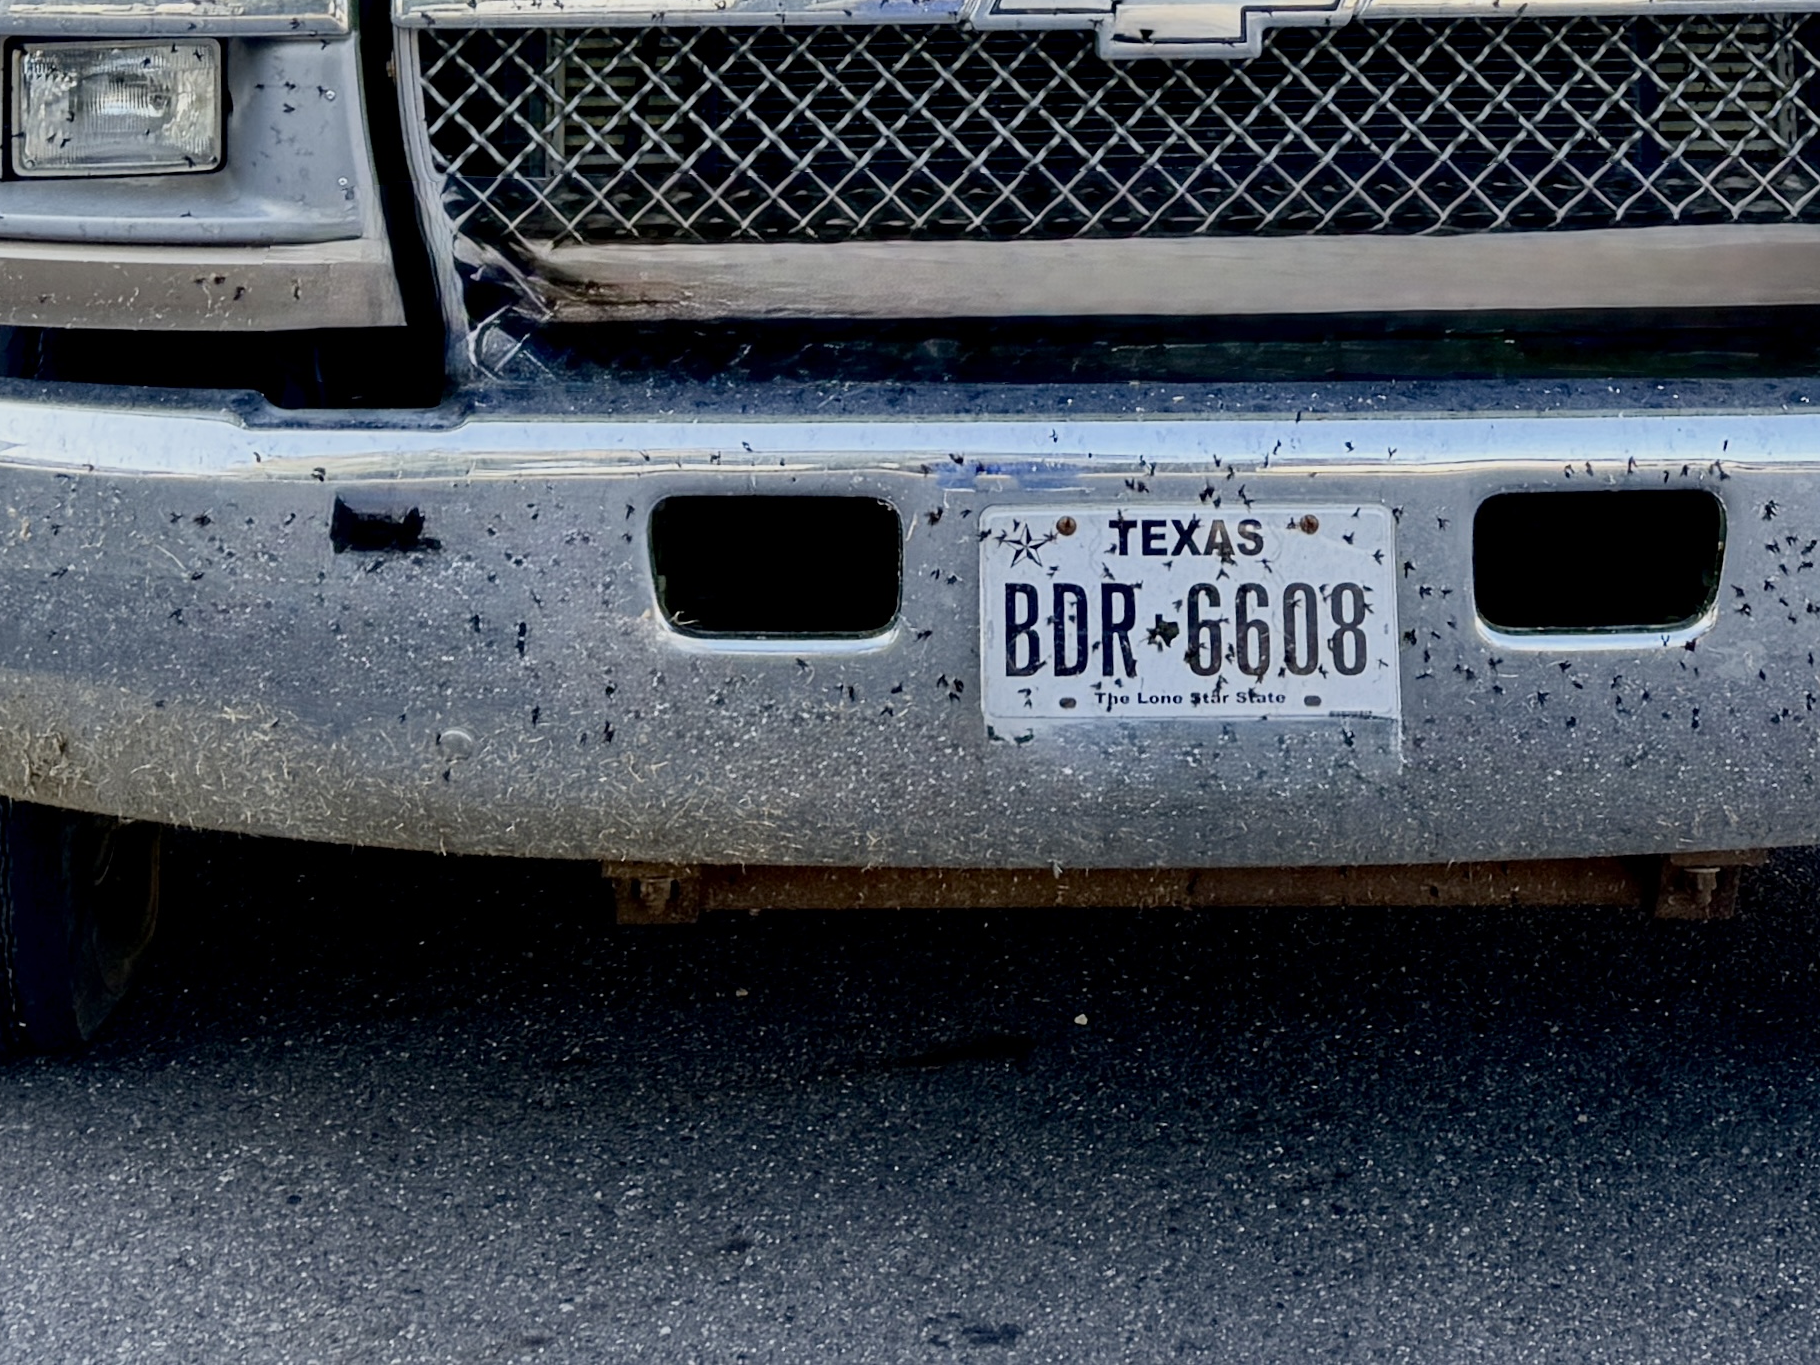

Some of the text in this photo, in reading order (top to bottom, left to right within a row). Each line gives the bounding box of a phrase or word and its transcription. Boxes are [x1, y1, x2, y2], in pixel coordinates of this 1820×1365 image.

[1109, 519, 1264, 556] TEXAS
[1005, 582, 1368, 677] BDR 6608
[1095, 692, 1286, 705] The Lone Star State
